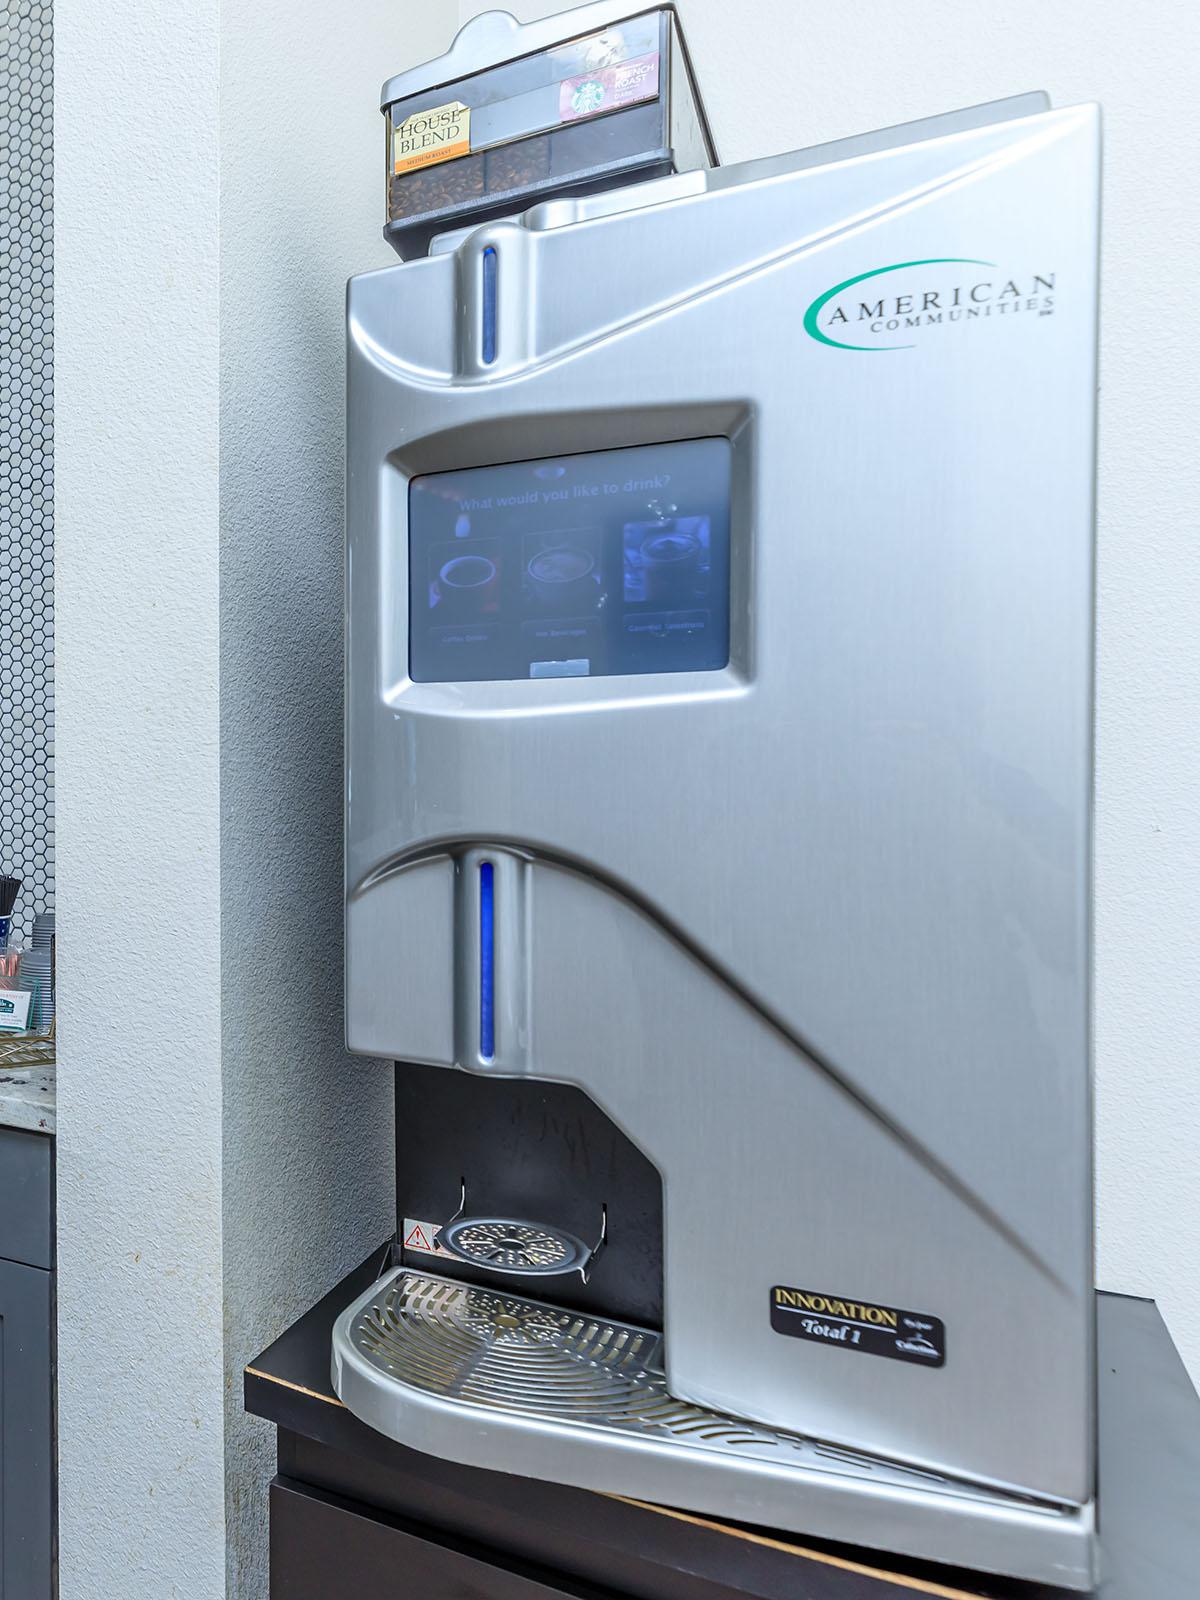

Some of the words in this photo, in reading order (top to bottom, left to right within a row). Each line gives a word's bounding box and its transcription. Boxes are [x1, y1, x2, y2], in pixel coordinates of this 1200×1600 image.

[614, 74, 647, 89] ROAST
[400, 110, 461, 139] HOUSE
[400, 125, 460, 153] BLEND
[432, 149, 452, 159] ROAST
[827, 272, 1055, 326] AMERICAN
[869, 296, 1055, 334] COMMUNITIES
[458, 497, 492, 511] What
[496, 491, 539, 507] would
[543, 489, 569, 502] you
[573, 485, 599, 498] like
[603, 483, 618, 495] to
[622, 475, 671, 493] drink?
[775, 1287, 897, 1327] INNOVATION
[801, 1318, 851, 1341] Total
[851, 1330, 861, 1344] 1
